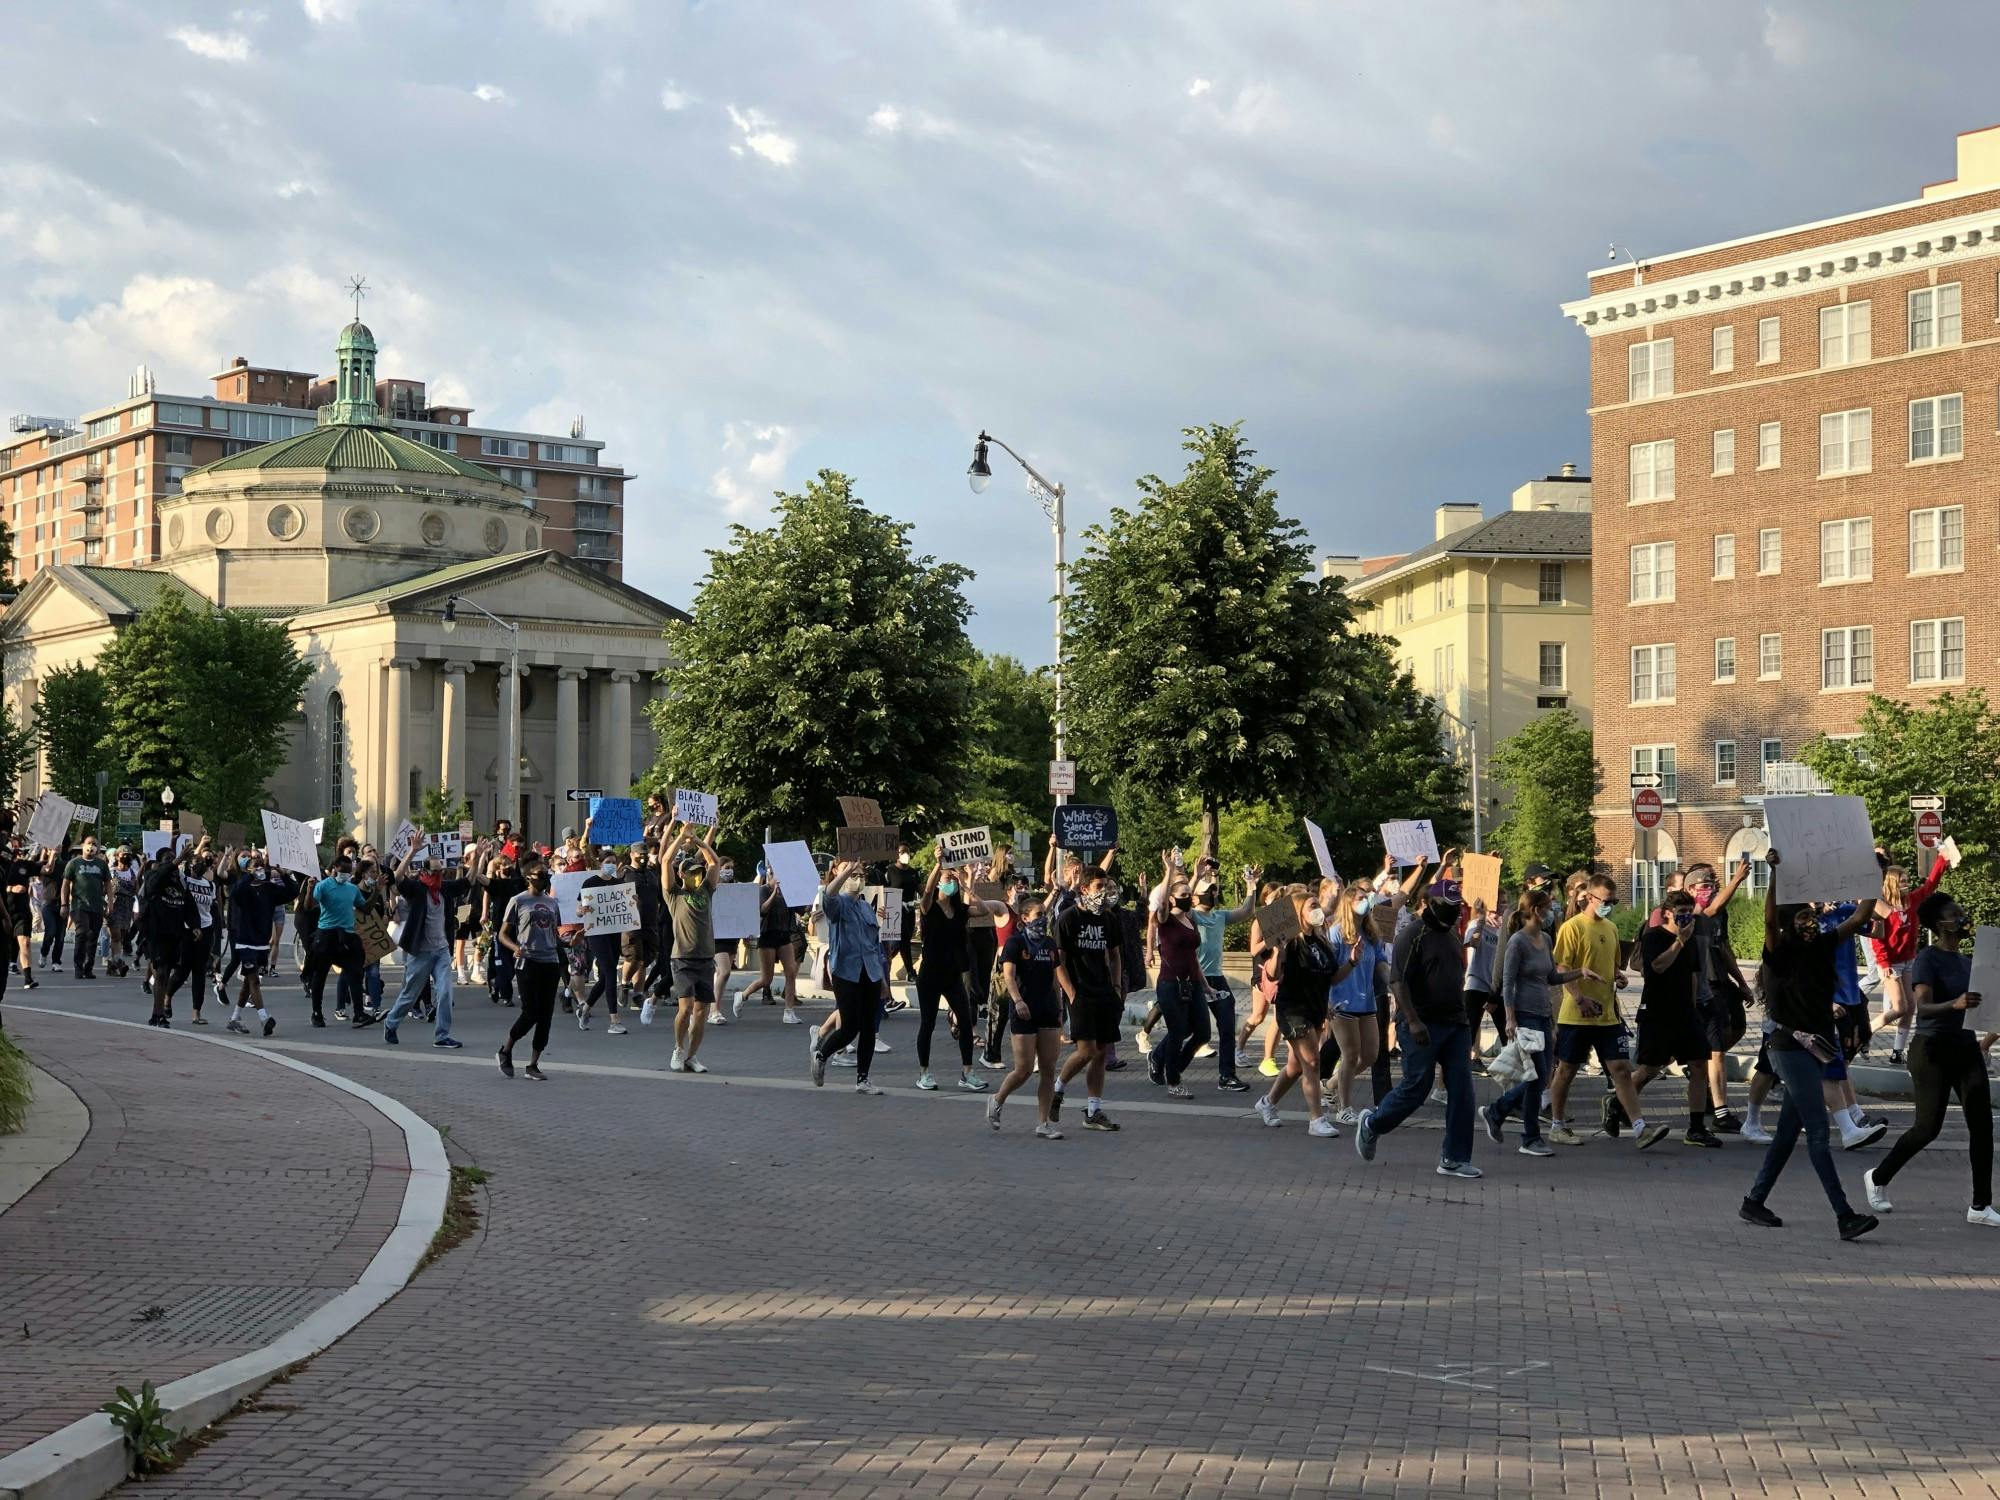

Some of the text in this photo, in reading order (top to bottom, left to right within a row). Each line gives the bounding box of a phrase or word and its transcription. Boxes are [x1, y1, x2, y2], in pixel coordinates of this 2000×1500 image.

[679, 790, 702, 803] BLACK
[1638, 796, 1658, 804] DO NOT
[684, 802, 705, 814] LIVES
[689, 812, 717, 826] MATTER
[1062, 810, 1092, 823] White
[1640, 813, 1657, 821] ENTER
[270, 814, 301, 835] BLACK
[1416, 822, 1429, 833] 4
[941, 831, 986, 848] I STAND
[943, 844, 989, 863] WITH YOU
[597, 890, 627, 904] BLACK
[598, 901, 627, 915] LIVES
[596, 912, 633, 927] MATTER
